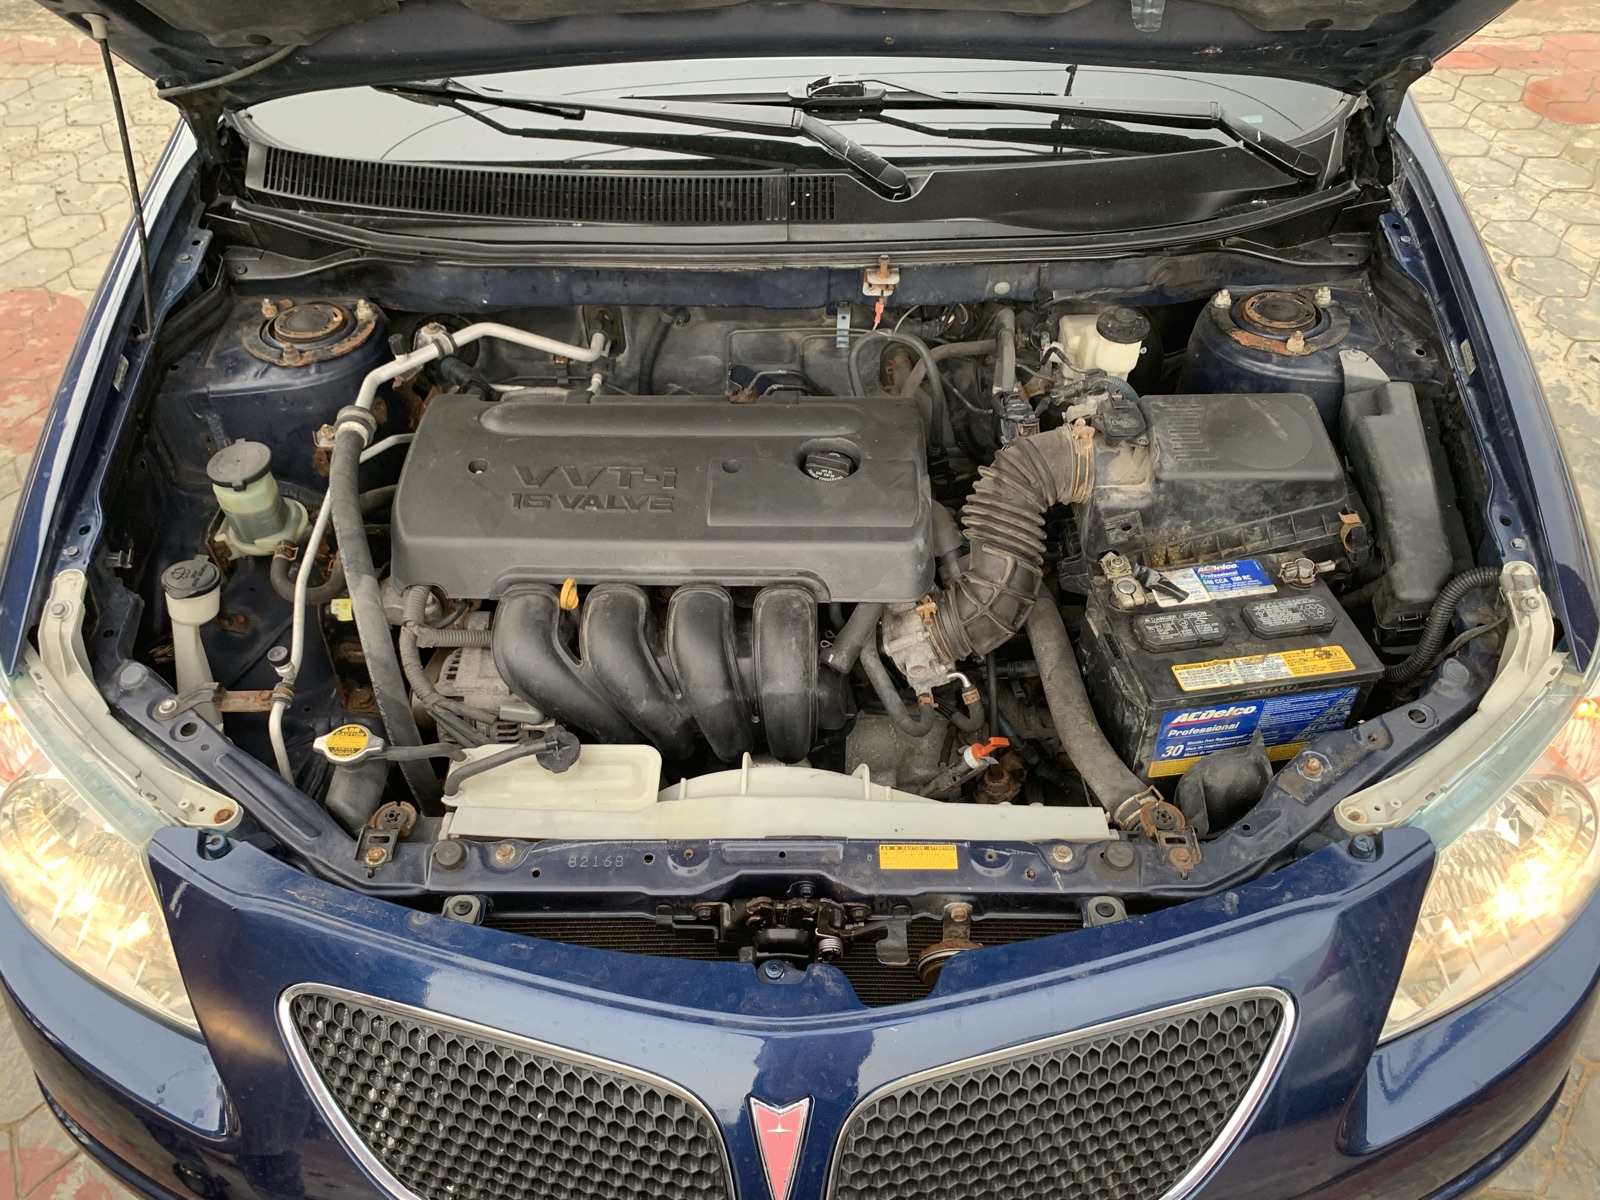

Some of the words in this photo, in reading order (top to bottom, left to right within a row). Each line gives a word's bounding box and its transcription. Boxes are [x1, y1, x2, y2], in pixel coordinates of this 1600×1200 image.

[513, 465, 678, 490] VVT-i
[510, 493, 551, 510] 16
[555, 493, 674, 513] VALVE
[1200, 570, 1239, 579] Professional
[1170, 705, 1258, 724] ACDelco
[1167, 721, 1241, 738] Professional
[1161, 744, 1185, 758] 30
[567, 854, 625, 869] 82168
